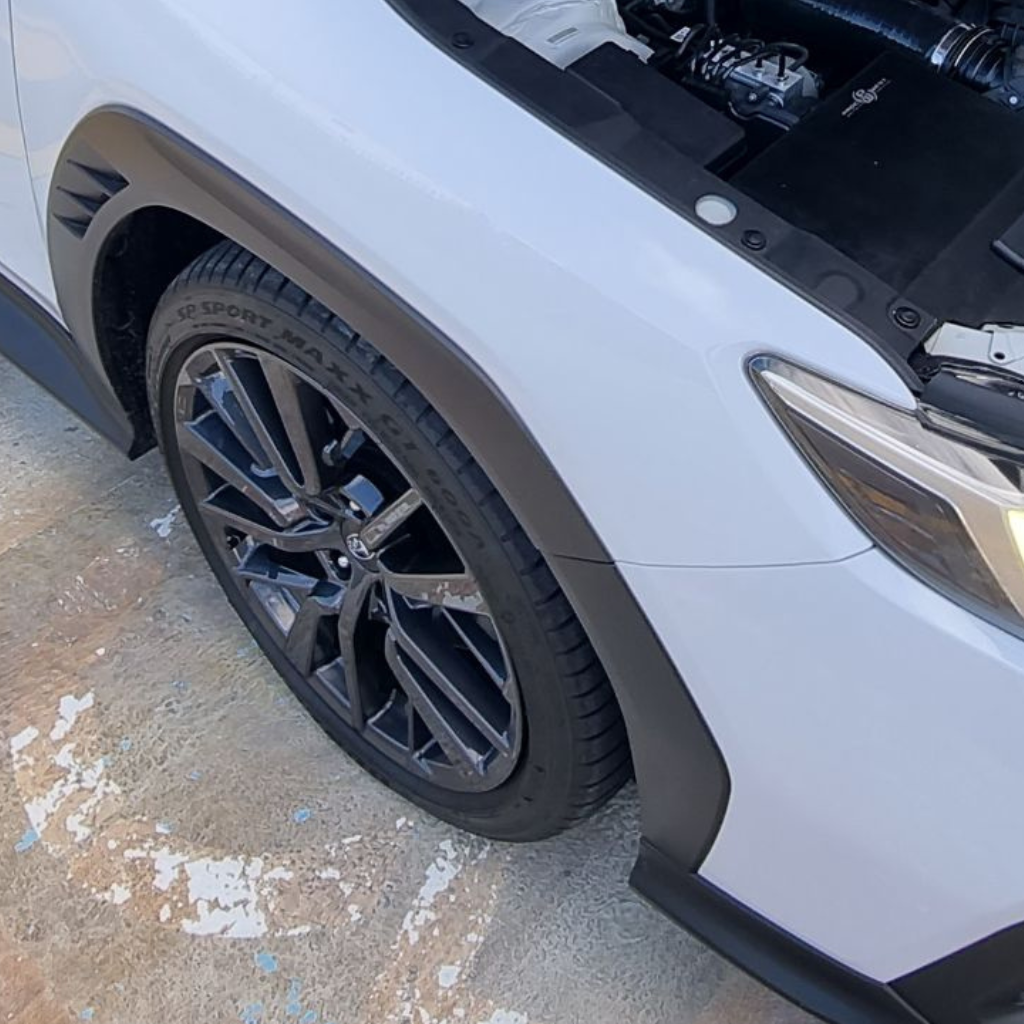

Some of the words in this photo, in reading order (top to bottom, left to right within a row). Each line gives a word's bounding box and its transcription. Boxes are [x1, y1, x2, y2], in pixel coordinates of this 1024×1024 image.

[177, 303, 196, 321] SP
[201, 300, 273, 329] SPORT
[281, 329, 373, 405] MAXX
